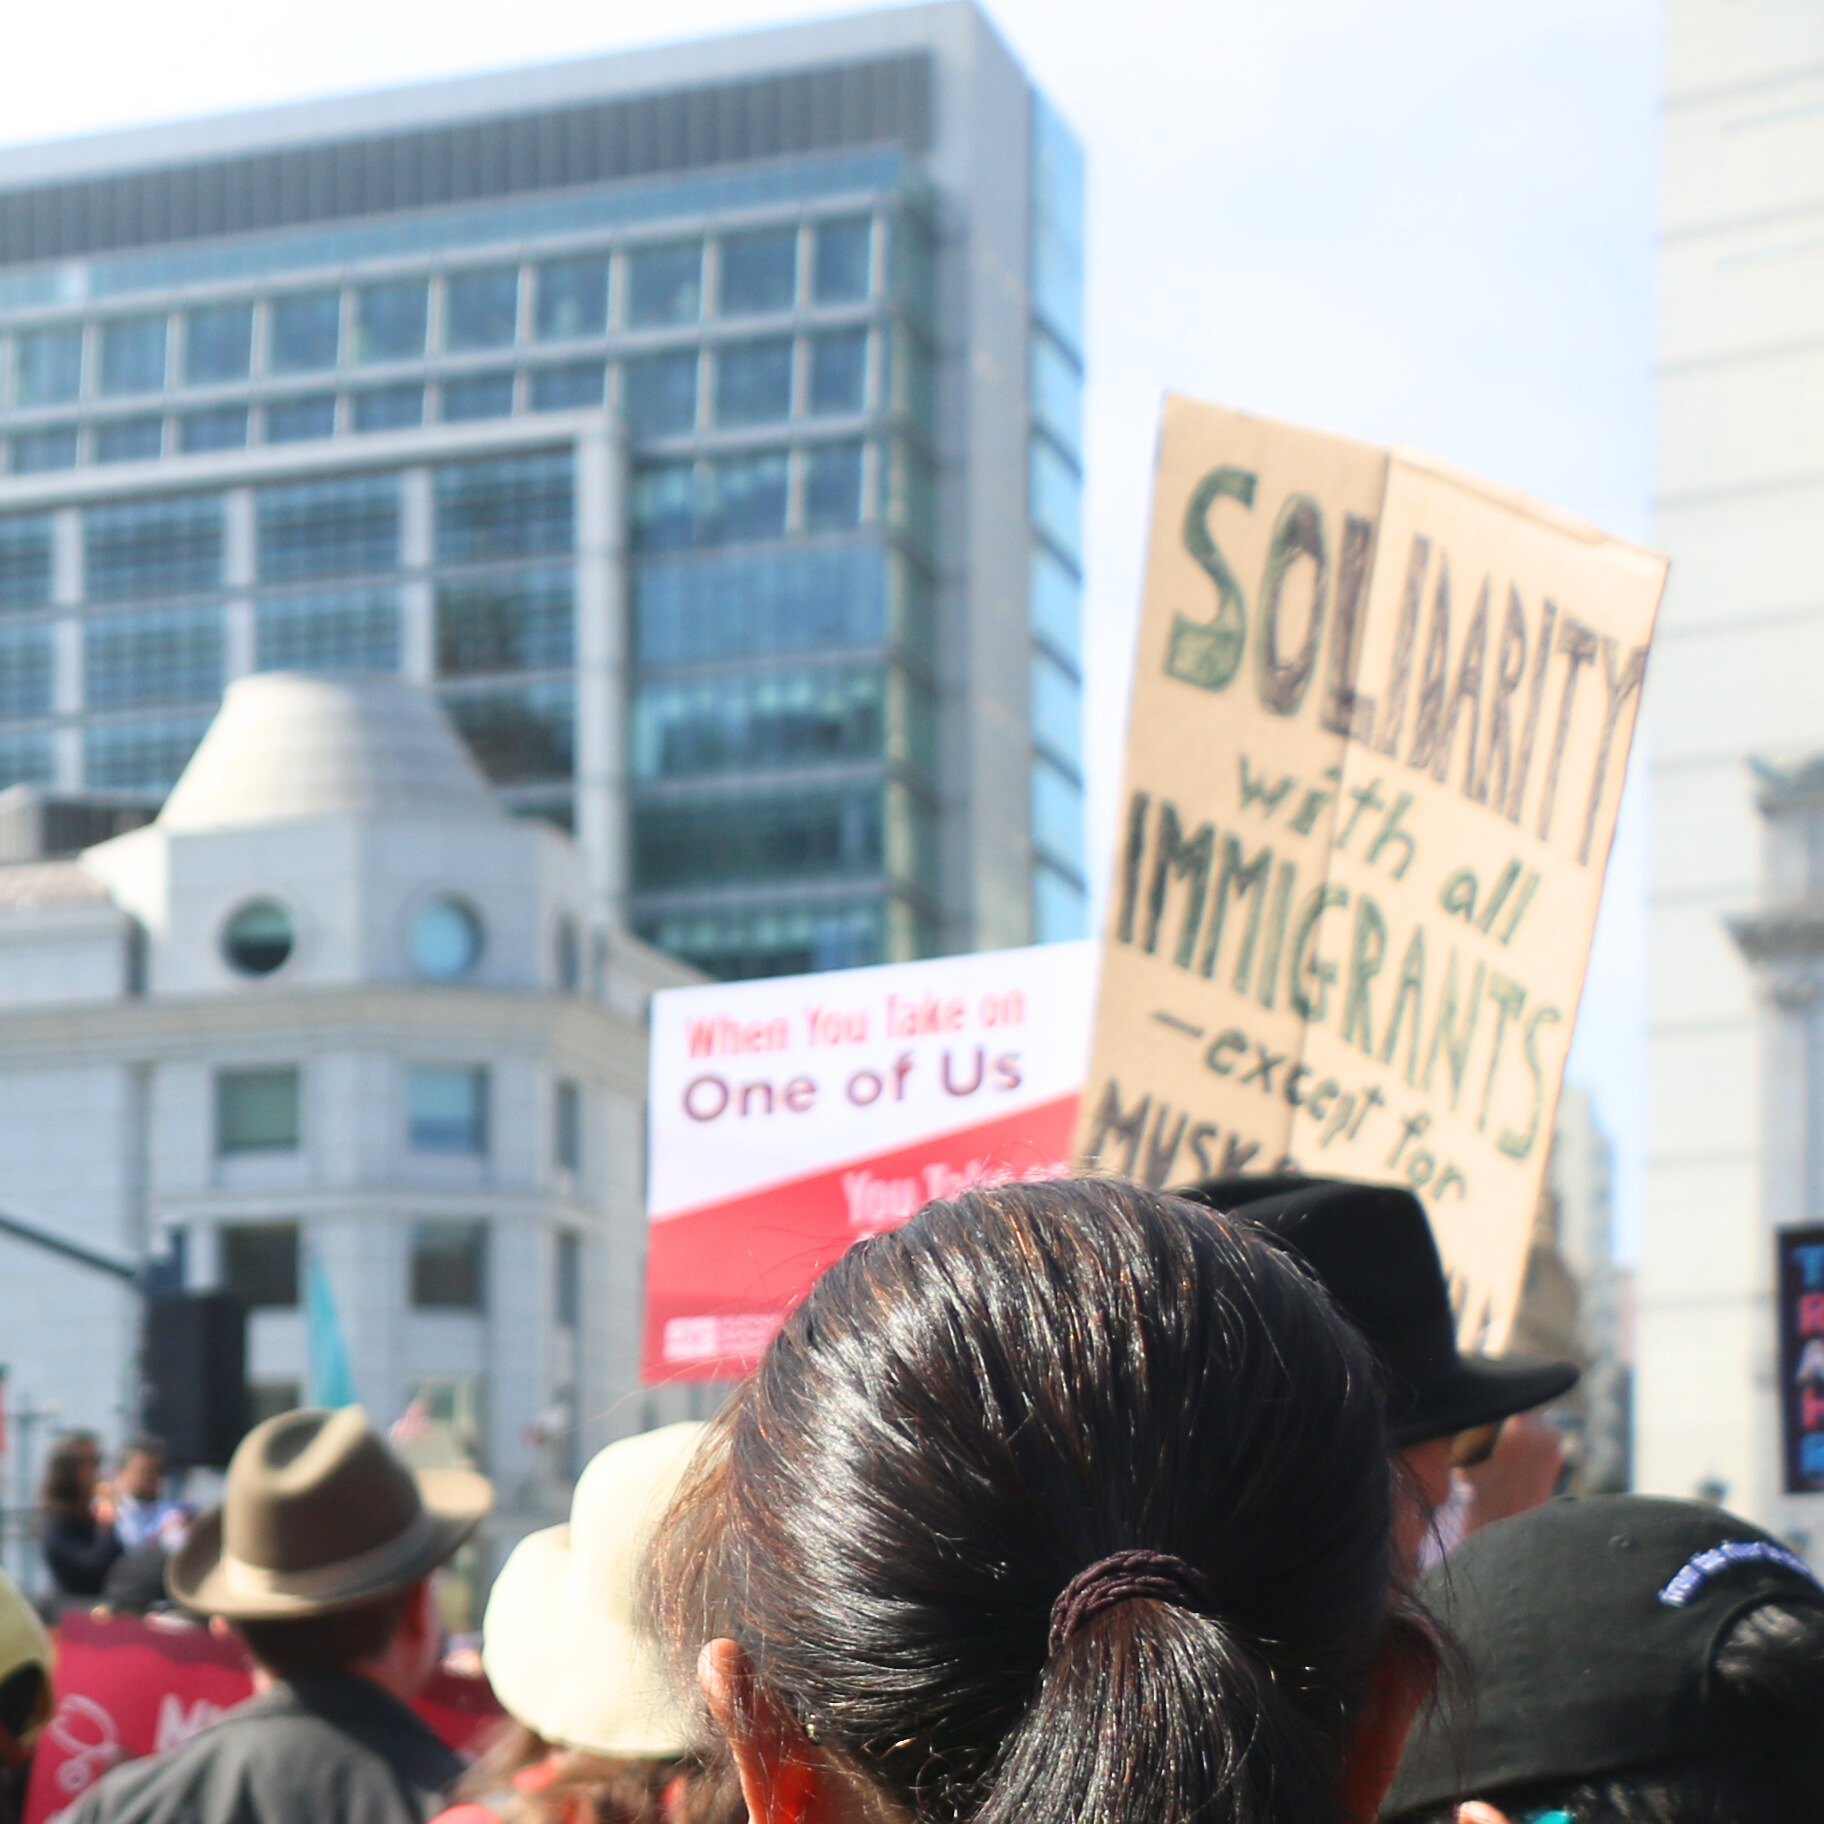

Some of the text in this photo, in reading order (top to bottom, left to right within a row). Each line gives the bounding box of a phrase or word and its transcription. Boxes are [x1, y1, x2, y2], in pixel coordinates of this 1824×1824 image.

[1164, 463, 1650, 867] SOLIDARITY
[1238, 752, 1542, 947] with all
[688, 989, 1025, 1058] When You Take on
[1116, 789, 1562, 1164] IMMIGRANTS
[683, 1046, 1024, 1123] One of Us
[1092, 1077, 1262, 1195] MUSK
[1385, 1108, 1468, 1202] for
